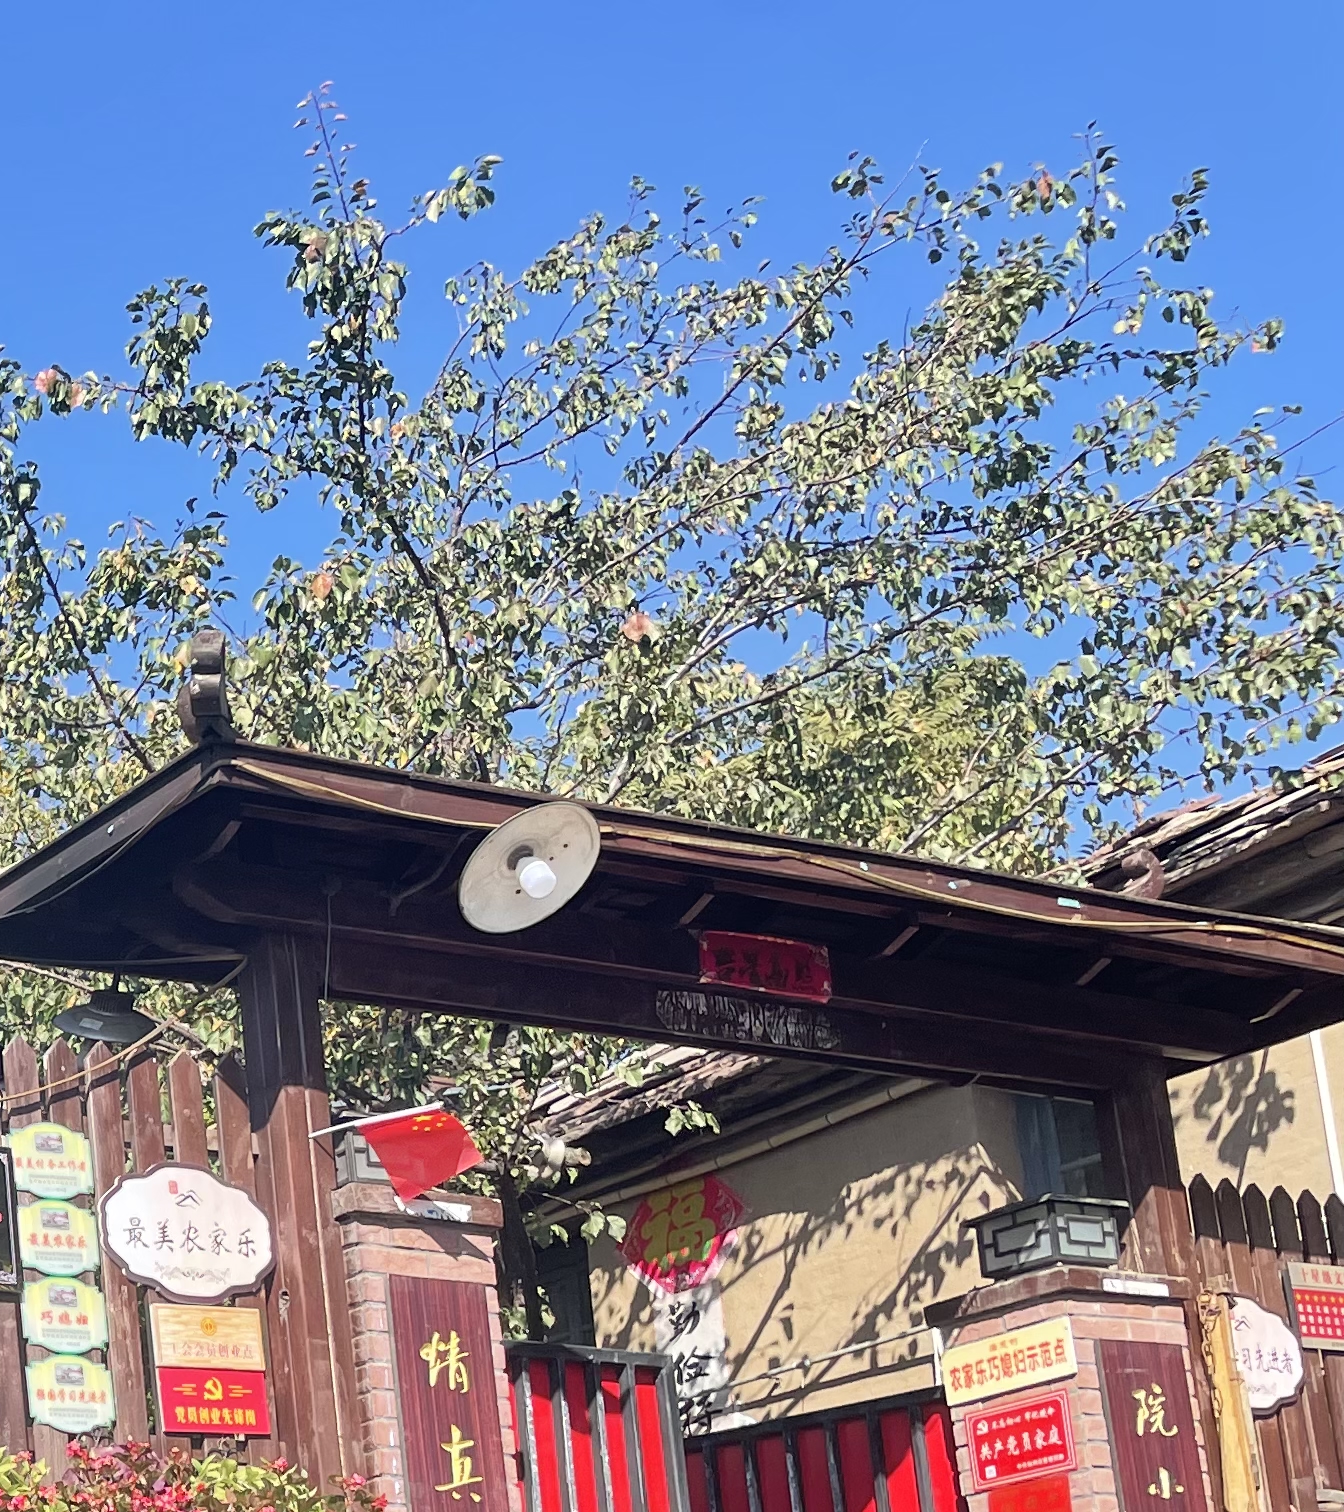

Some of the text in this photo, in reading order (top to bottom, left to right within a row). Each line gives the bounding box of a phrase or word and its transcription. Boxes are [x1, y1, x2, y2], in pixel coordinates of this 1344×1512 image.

[123, 1217, 256, 1258] 最美农家乐
[642, 1180, 717, 1264] 福
[950, 1338, 1067, 1392] 农家乐巧媳妇示范点
[1234, 1343, 1294, 1375] 习先进者
[175, 1406, 255, 1427] 党员创业先锋岗
[980, 1425, 1063, 1460] 共产党员家庭
